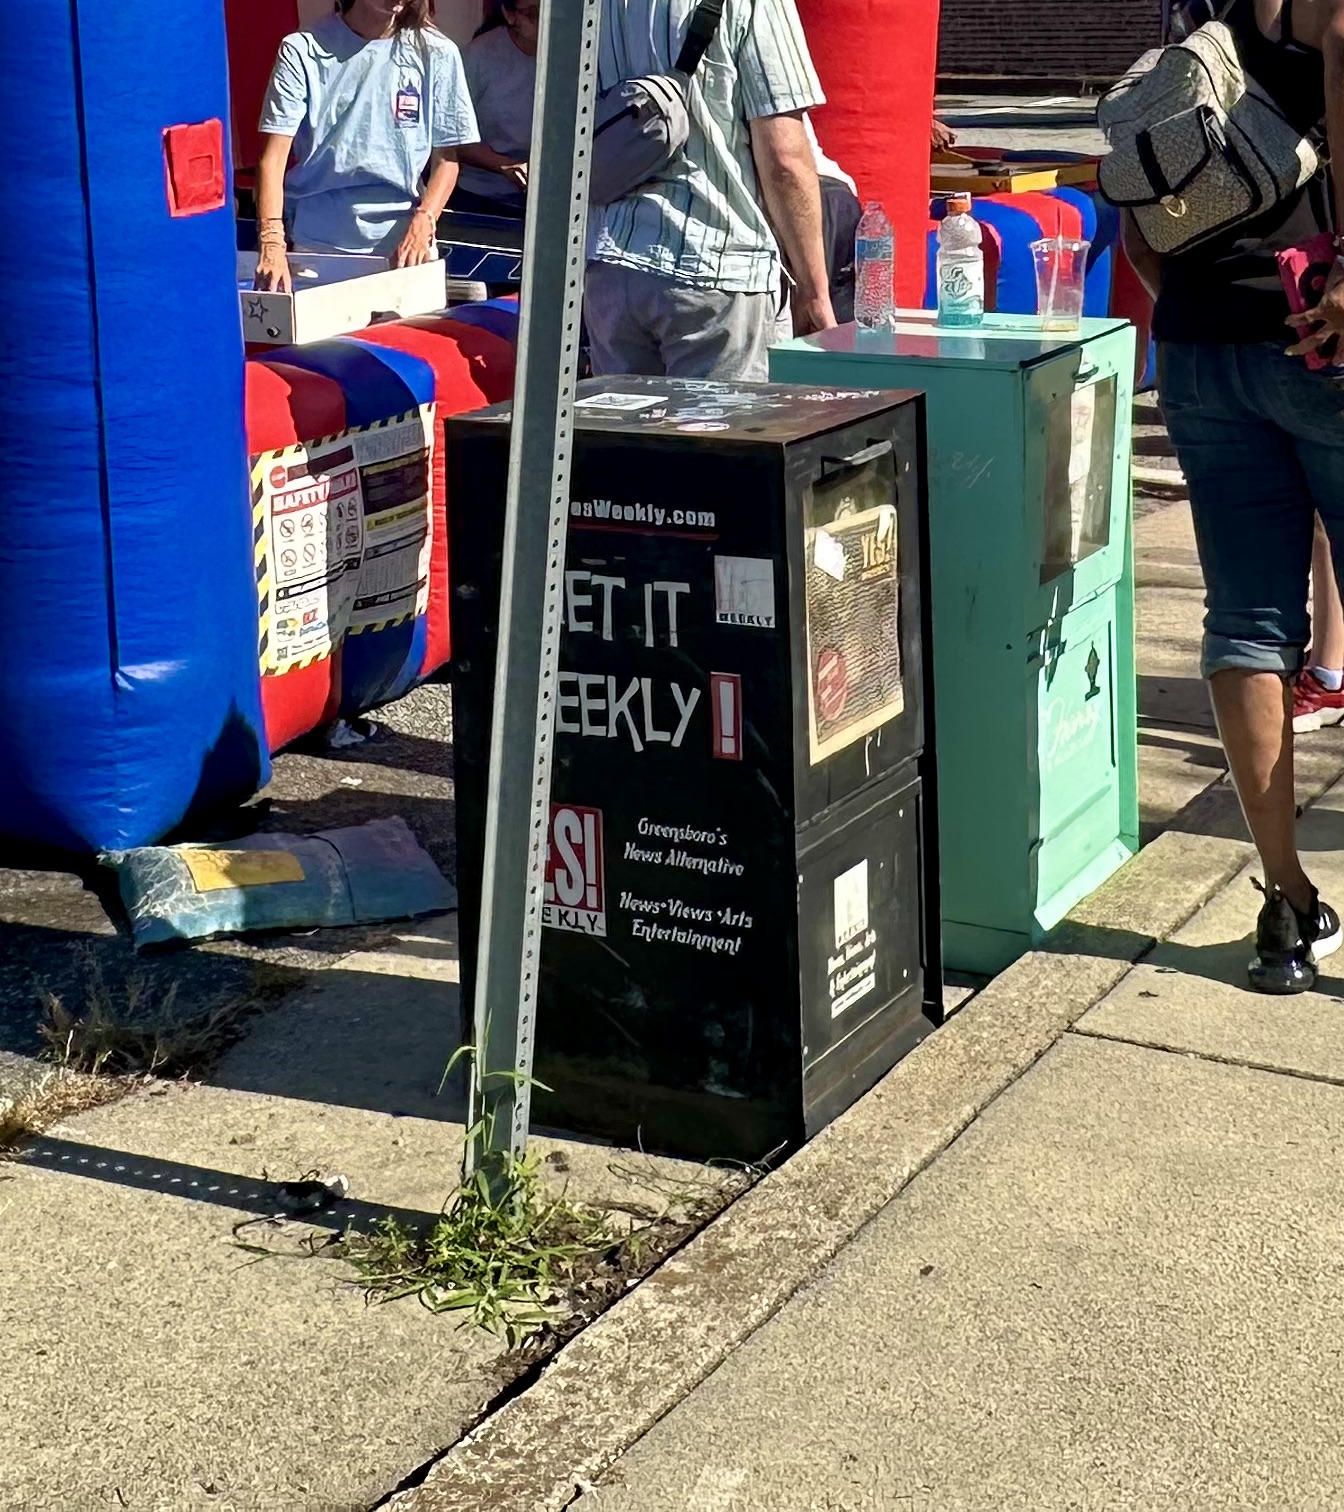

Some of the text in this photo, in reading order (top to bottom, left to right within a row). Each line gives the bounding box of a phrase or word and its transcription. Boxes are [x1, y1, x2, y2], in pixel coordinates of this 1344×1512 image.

[570, 499, 716, 527] esWeekly.com
[565, 571, 691, 648] ET IT
[556, 671, 702, 753] EEKLY
[638, 817, 728, 846] Greensboro's
[544, 808, 598, 908] S!
[623, 842, 745, 876] News Alternative
[542, 906, 598, 932] EKLY
[632, 919, 743, 956] Entertainment
